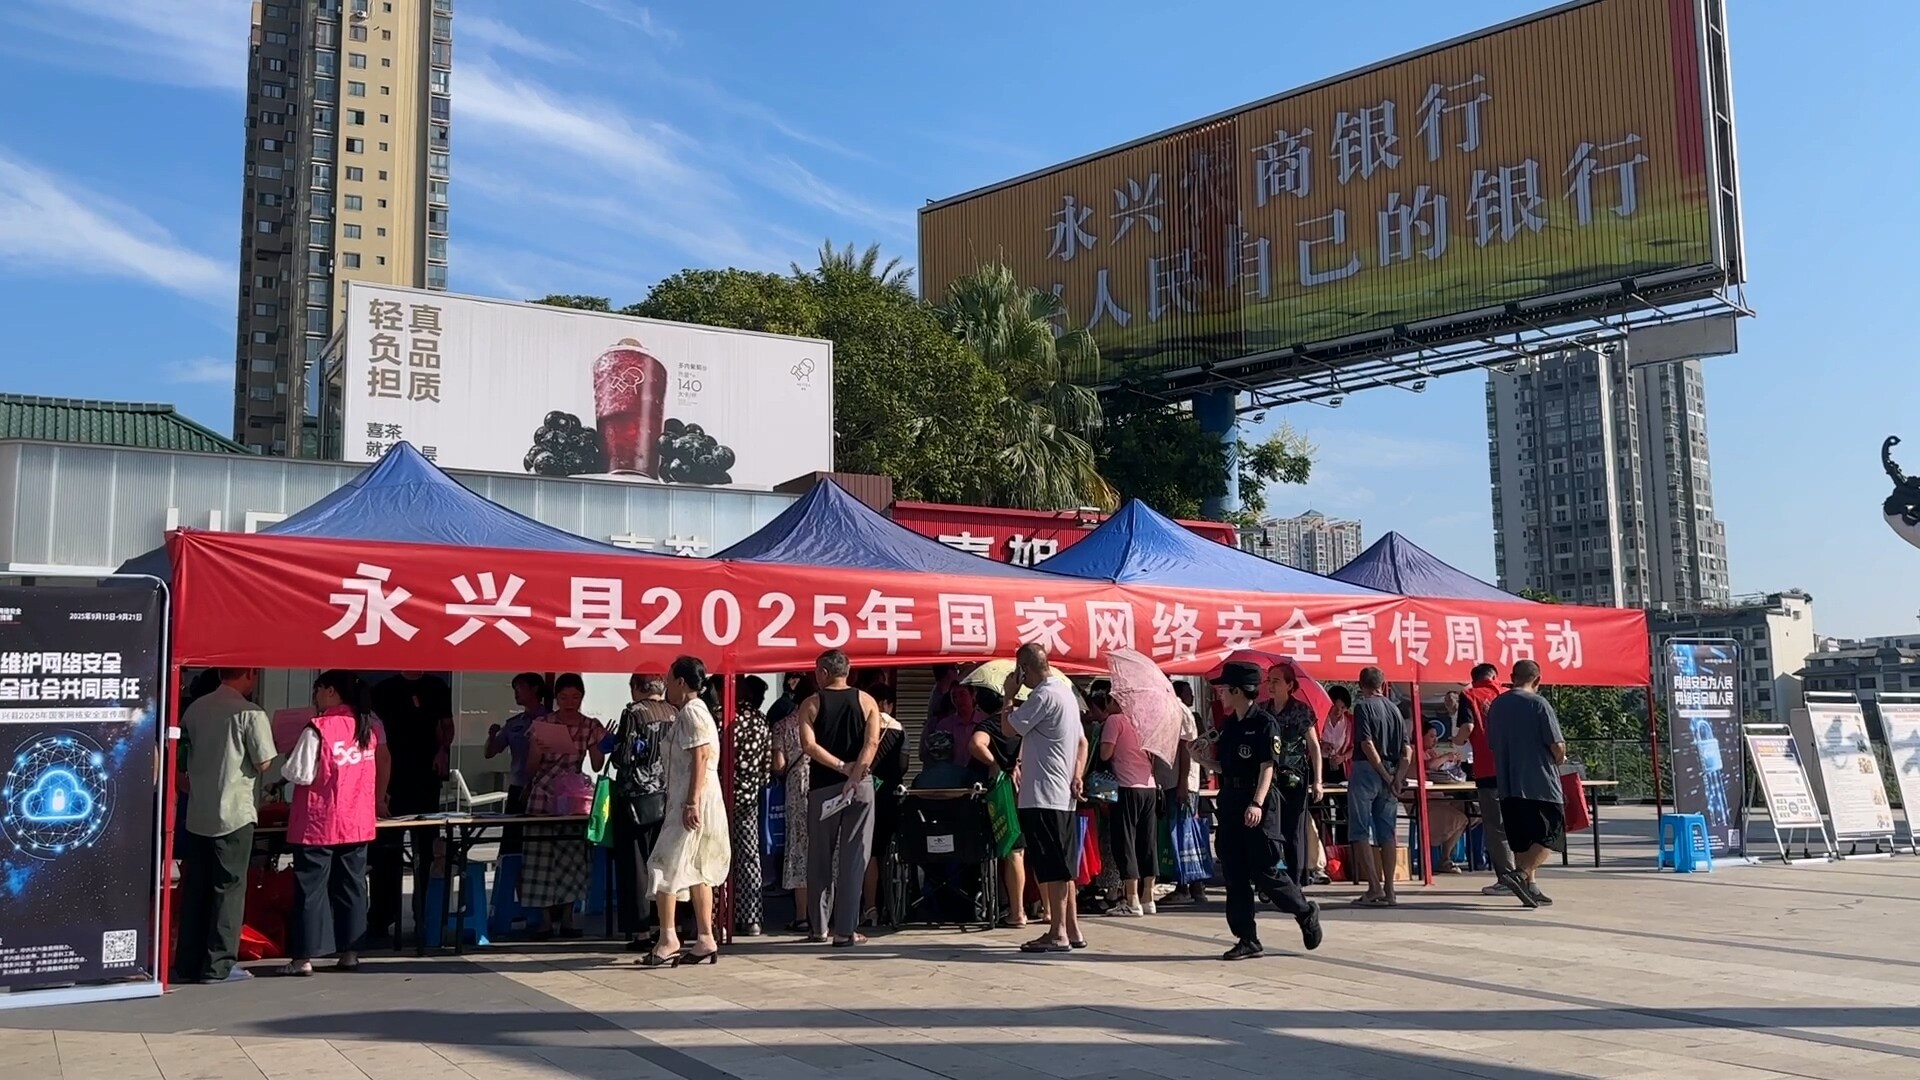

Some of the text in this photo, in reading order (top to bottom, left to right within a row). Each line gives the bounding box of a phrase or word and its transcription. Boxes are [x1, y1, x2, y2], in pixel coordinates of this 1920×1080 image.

[1045, 72, 1492, 262] 永兴商银行
[368, 298, 404, 400] 轻负担
[407, 303, 443, 403] 真品质
[677, 378, 702, 392] 140
[366, 422, 402, 439] 喜茶
[366, 441, 438, 461] 就层
[323, 562, 1584, 670] 永兴县2025年国家网络安全宣传周活动
[0, 652, 122, 675] 维护网络安全
[0, 678, 140, 700] 全社会共同责任
[1674, 675, 1733, 689] 网络安全为人民
[333, 740, 362, 766] 5G
